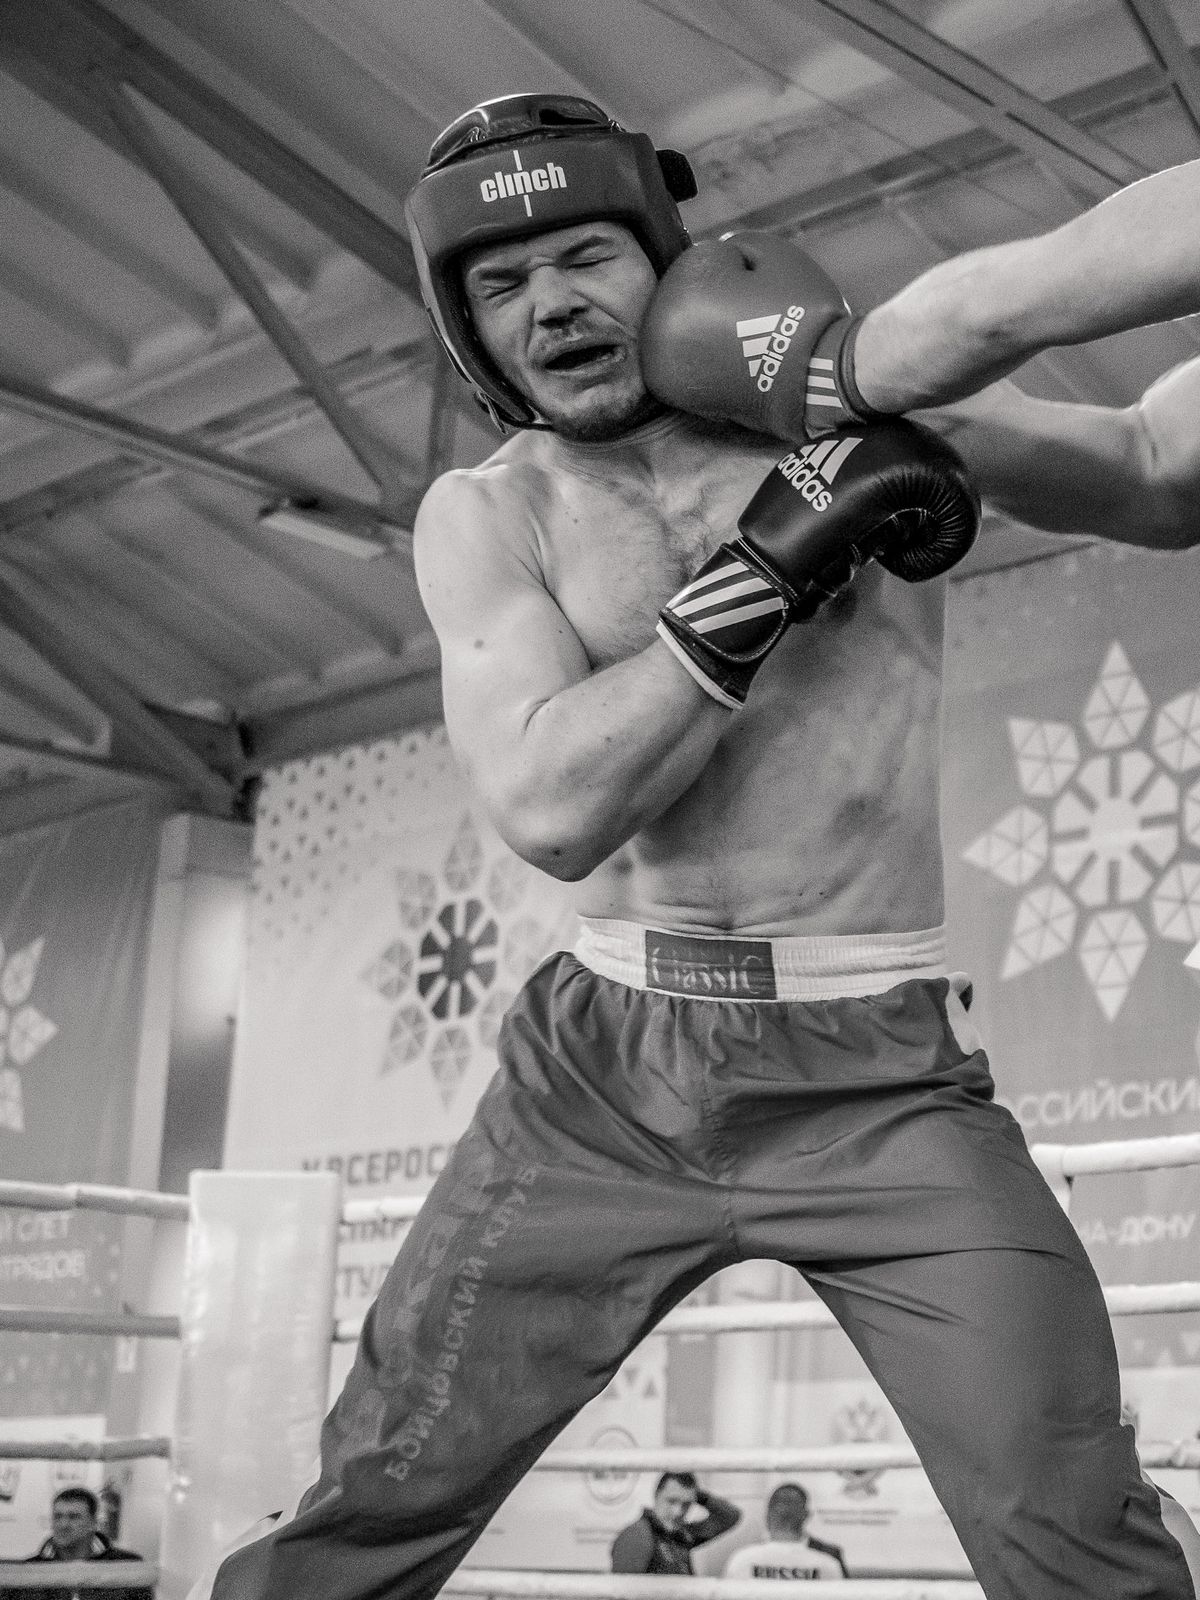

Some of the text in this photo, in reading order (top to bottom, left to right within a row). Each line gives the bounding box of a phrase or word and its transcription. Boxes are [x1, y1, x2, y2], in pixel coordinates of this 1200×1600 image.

[480, 162, 567, 203] clinch
[757, 305, 806, 393] adidas
[777, 452, 833, 512] adidas
